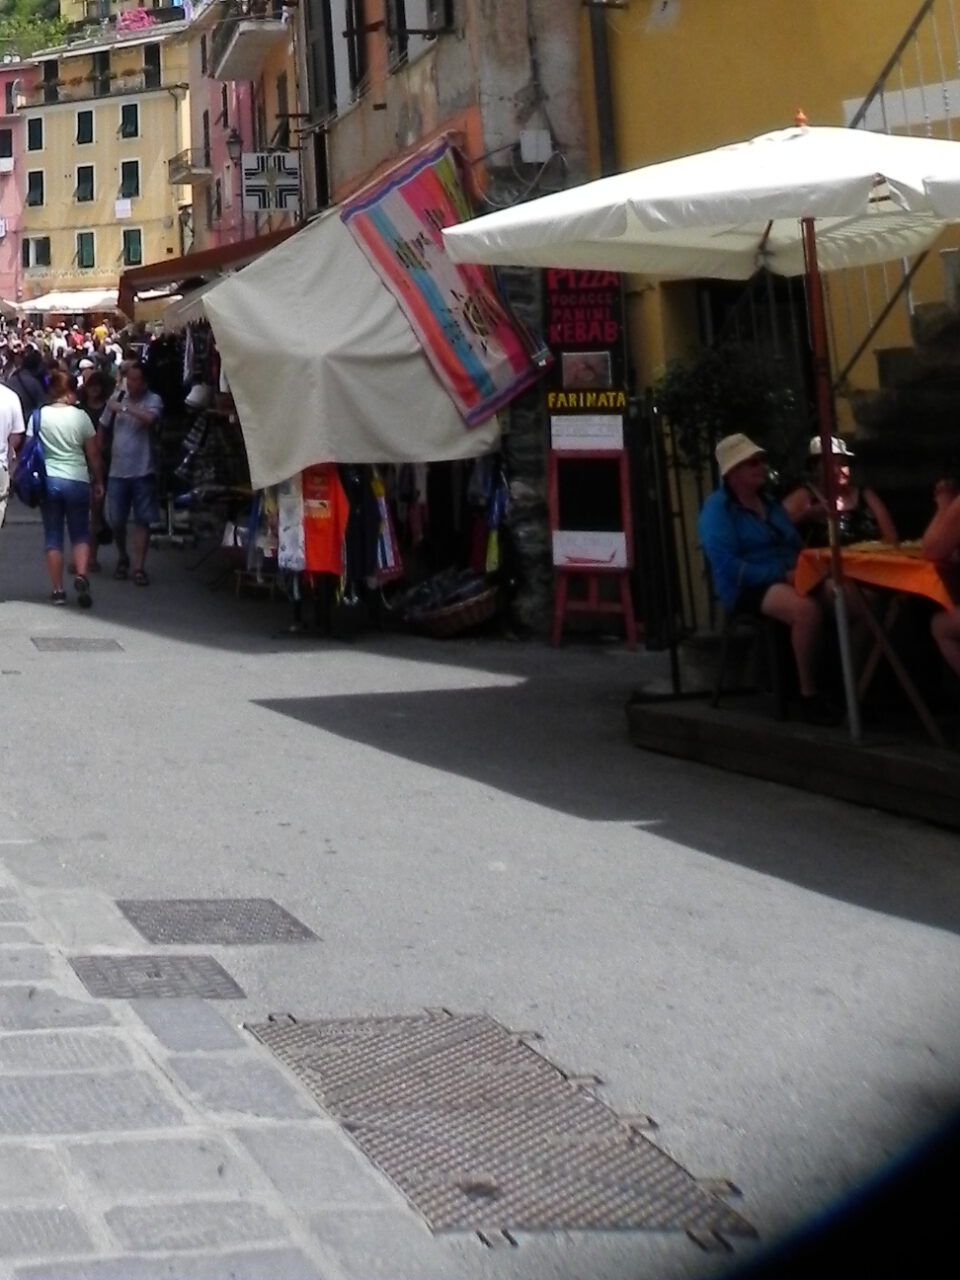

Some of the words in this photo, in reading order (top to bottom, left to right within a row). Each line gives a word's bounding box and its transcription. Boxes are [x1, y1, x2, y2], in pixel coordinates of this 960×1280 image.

[546, 269, 619, 289] PIZZA
[551, 307, 611, 322] PANINI
[549, 321, 618, 343] KEBAB
[547, 391, 626, 409] FARINATA
